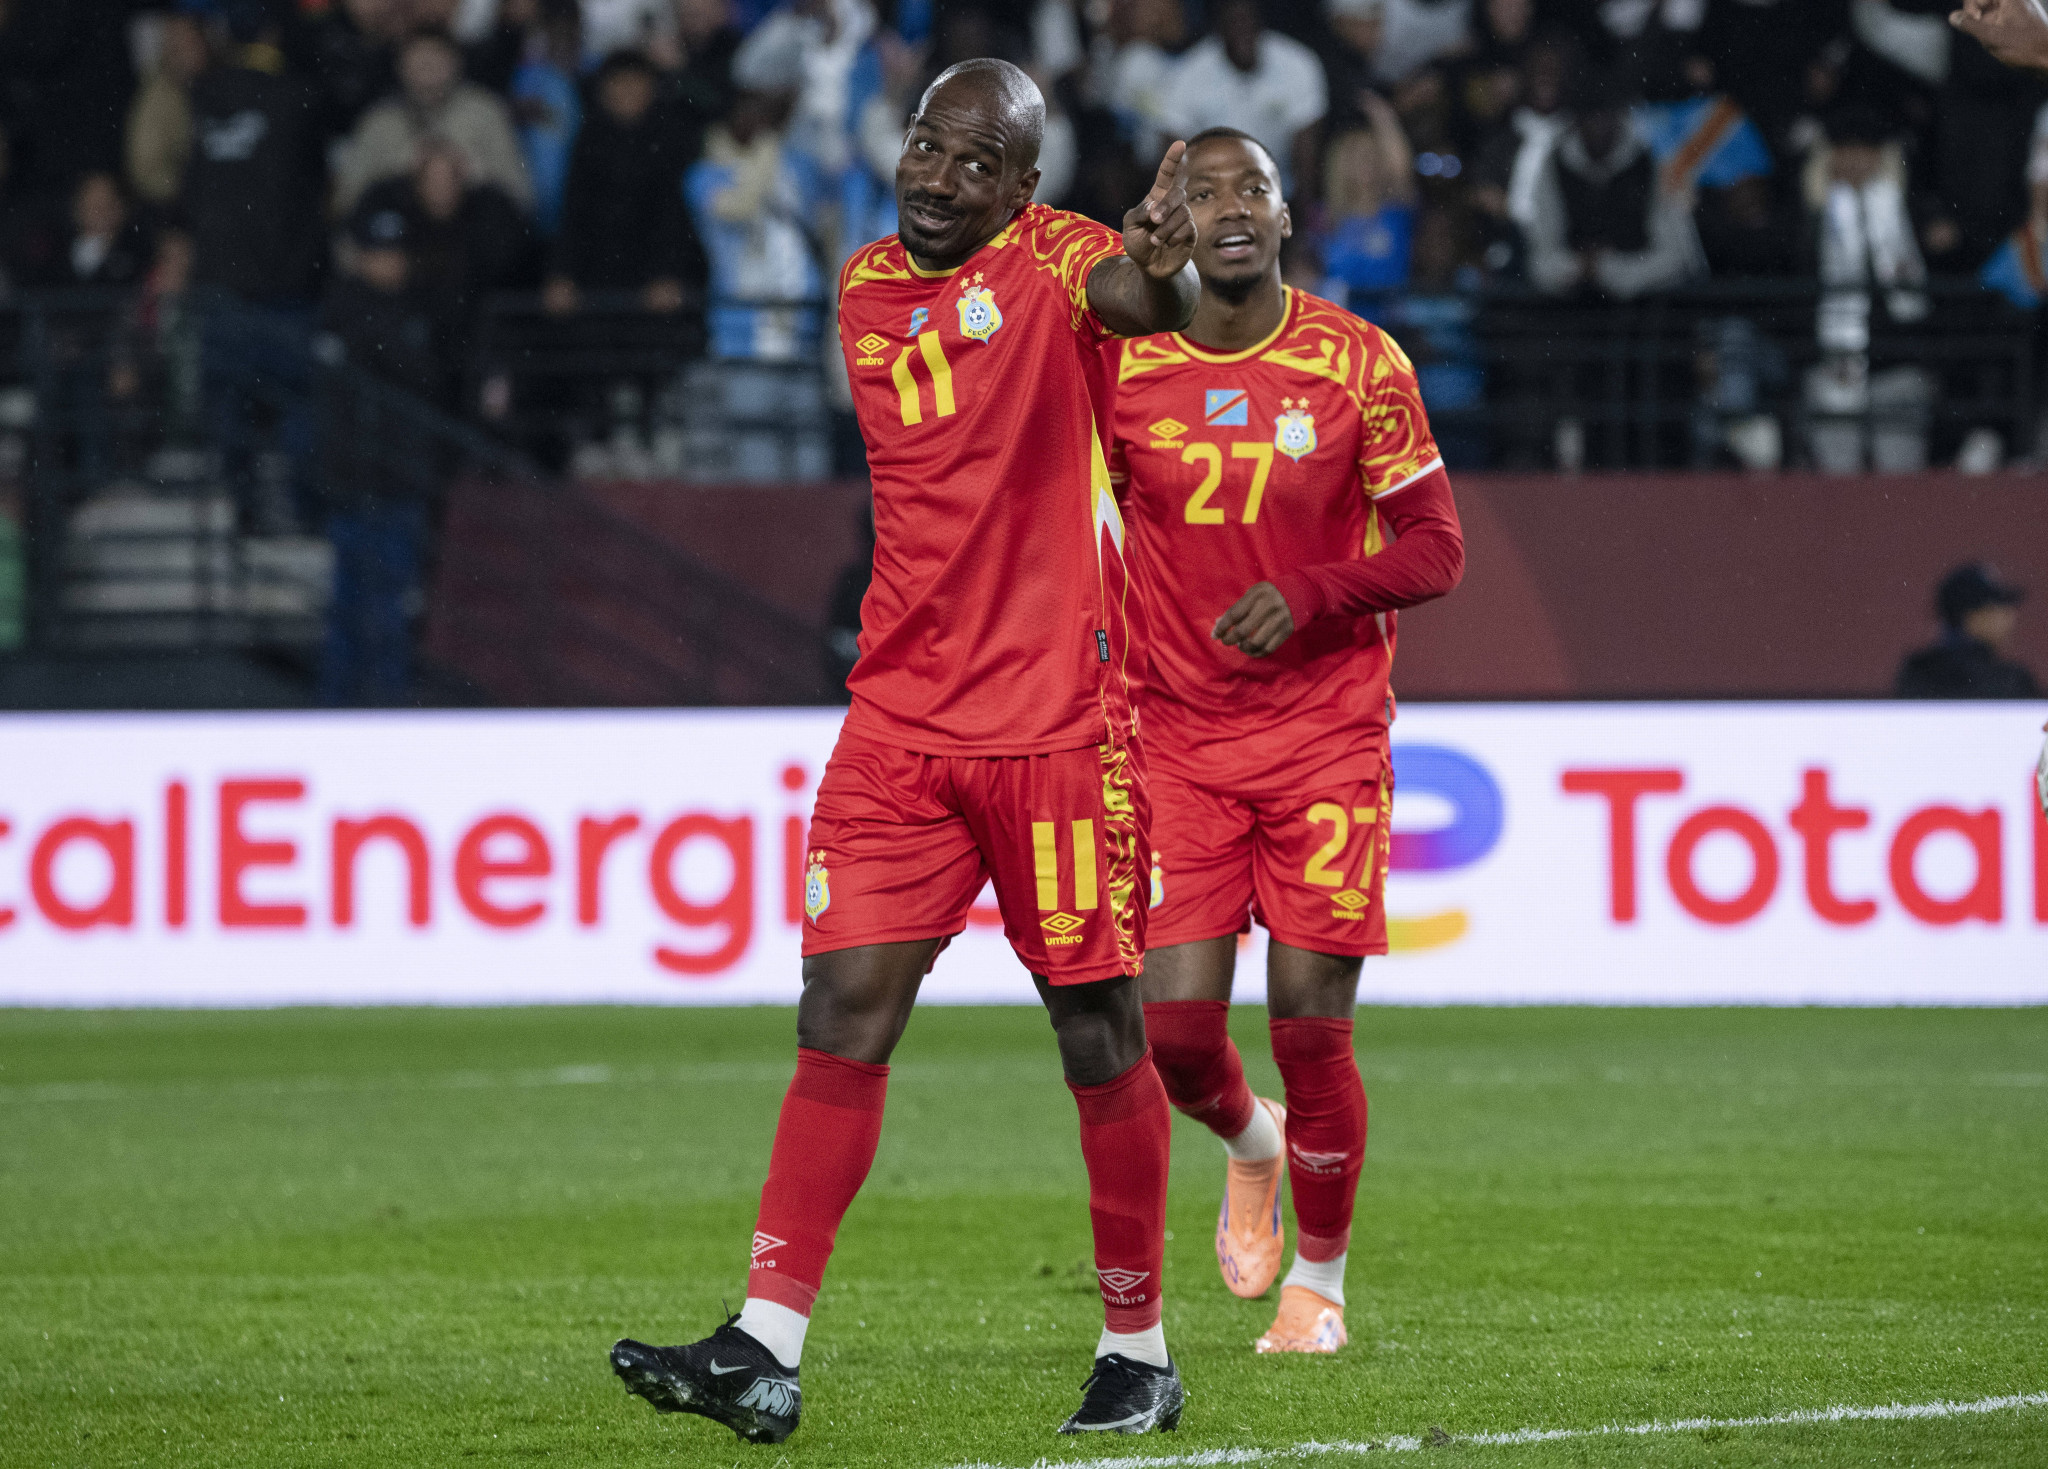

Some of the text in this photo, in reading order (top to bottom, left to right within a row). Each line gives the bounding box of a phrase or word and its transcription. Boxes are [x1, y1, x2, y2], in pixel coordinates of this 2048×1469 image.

[967, 321, 995, 336] FECOFA
[856, 355, 885, 366] umbro
[891, 329, 957, 427] 11
[1181, 441, 1275, 525] 27
[1303, 802, 1378, 889] 27
[1031, 818, 1098, 911] 11
[1045, 934, 1083, 946] umbro
[750, 1258, 777, 1270] bro
[1101, 1290, 1146, 1305] umbro
